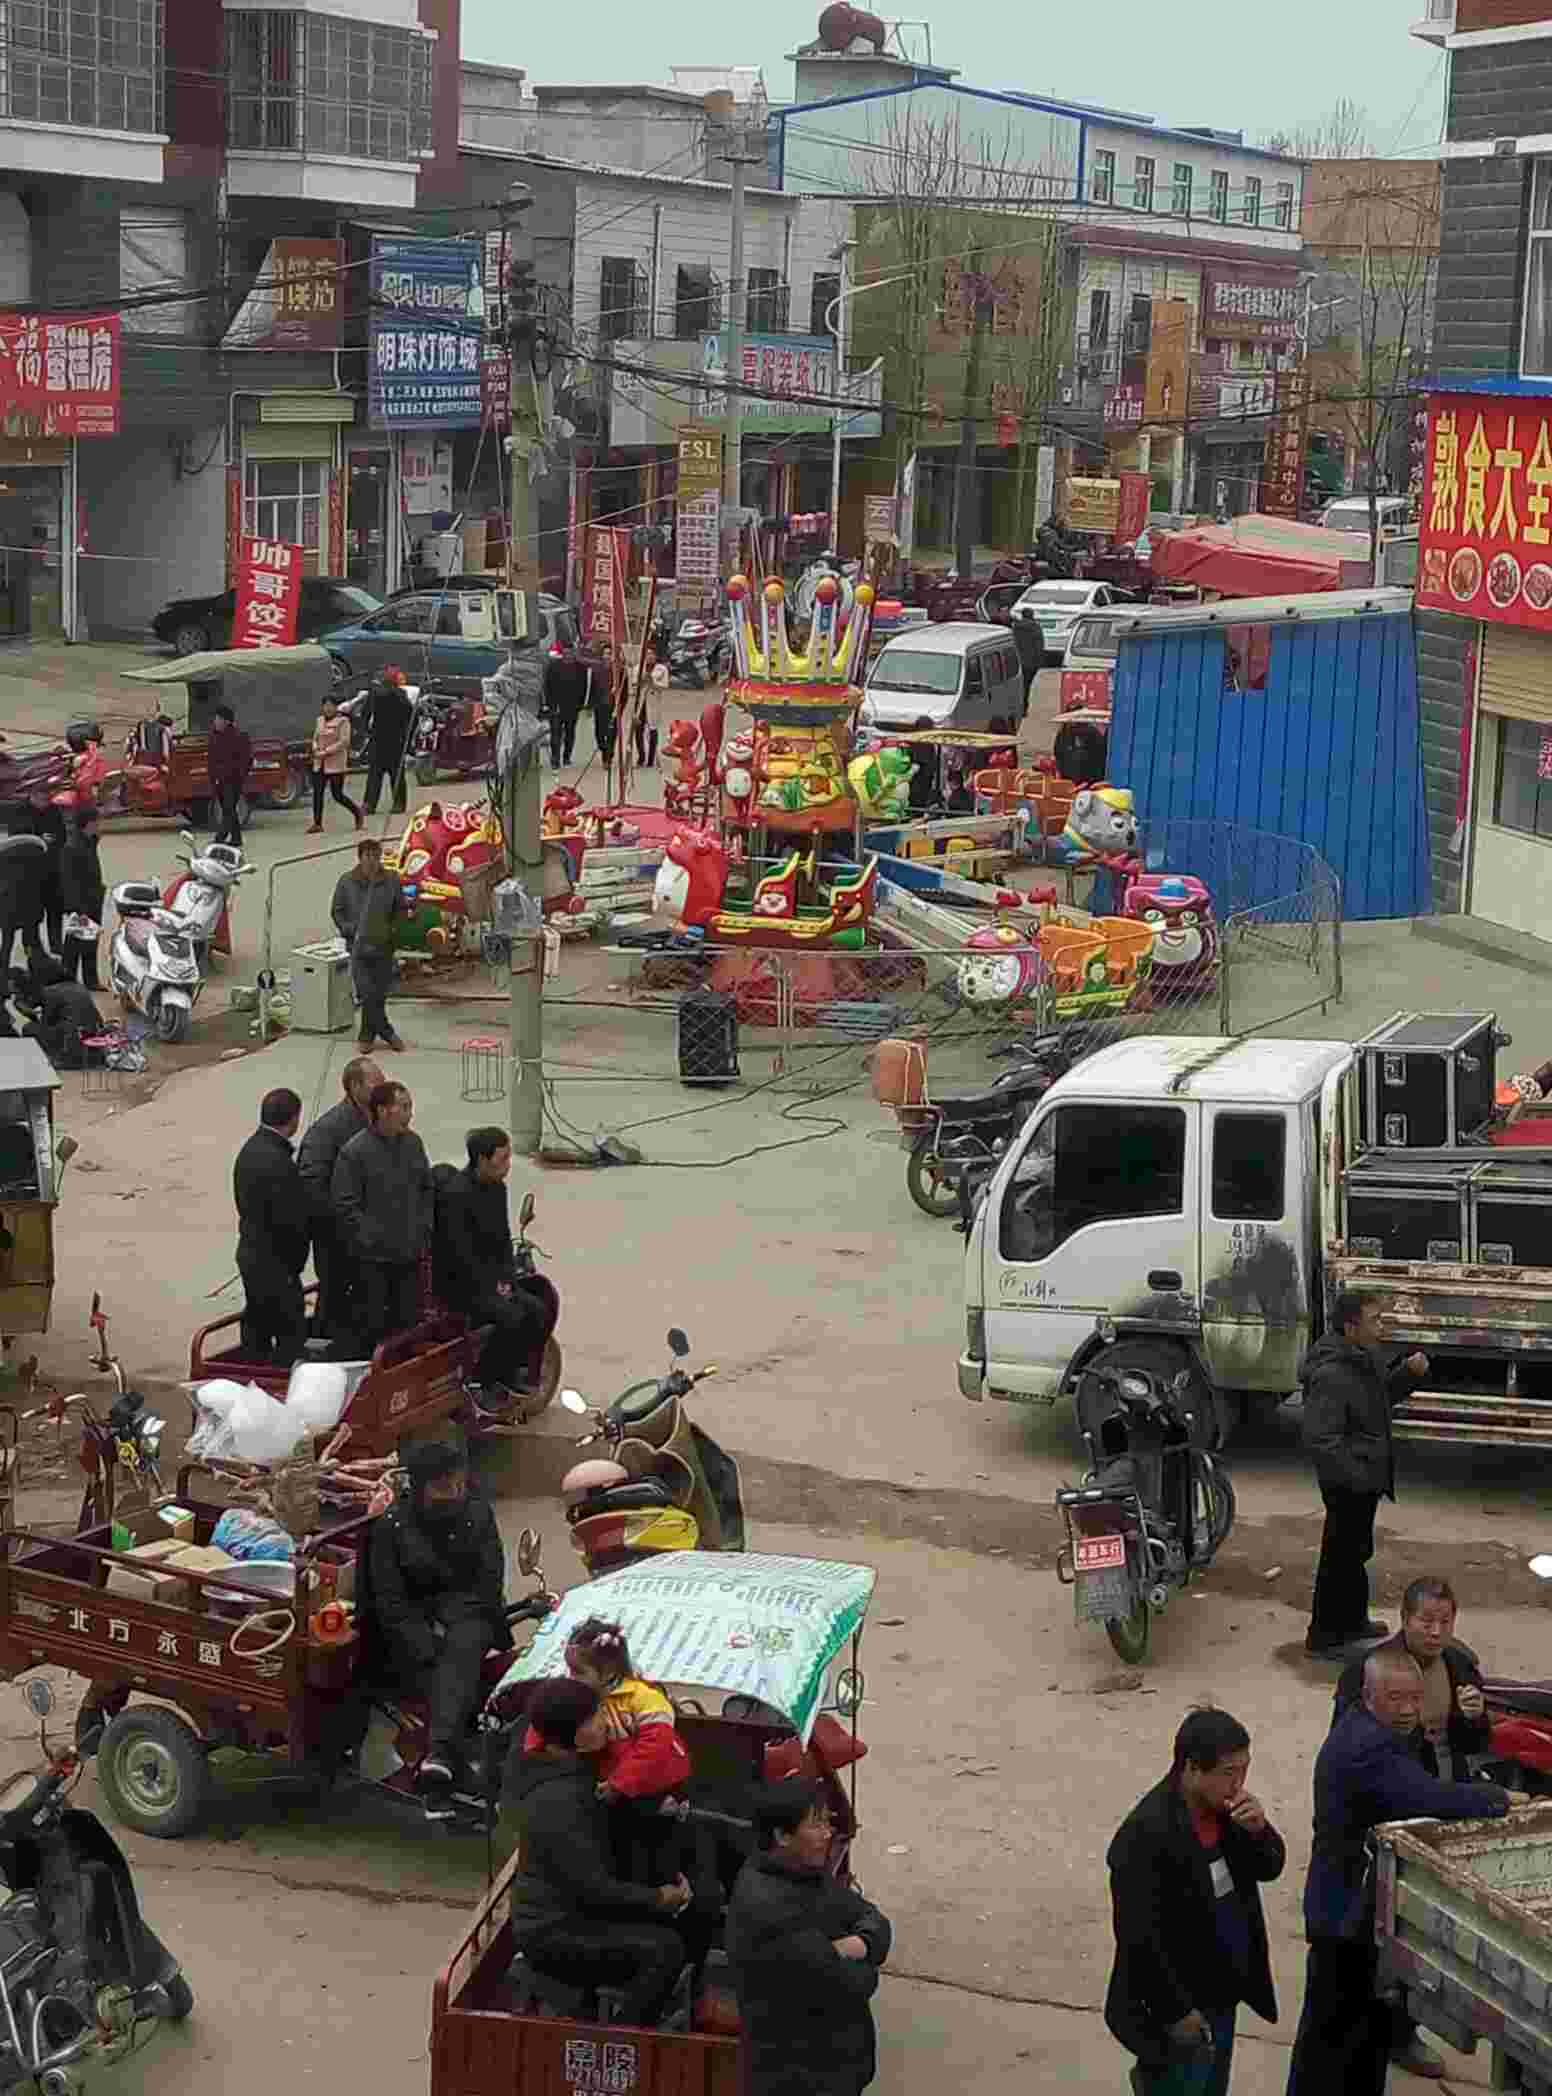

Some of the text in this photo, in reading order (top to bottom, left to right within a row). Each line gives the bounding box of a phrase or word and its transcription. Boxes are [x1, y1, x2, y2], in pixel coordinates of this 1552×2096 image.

[1429, 410, 1552, 544] 熟食大全
[243, 541, 291, 648] 帅哥饺子
[68, 1608, 222, 1666] 北方永盛
